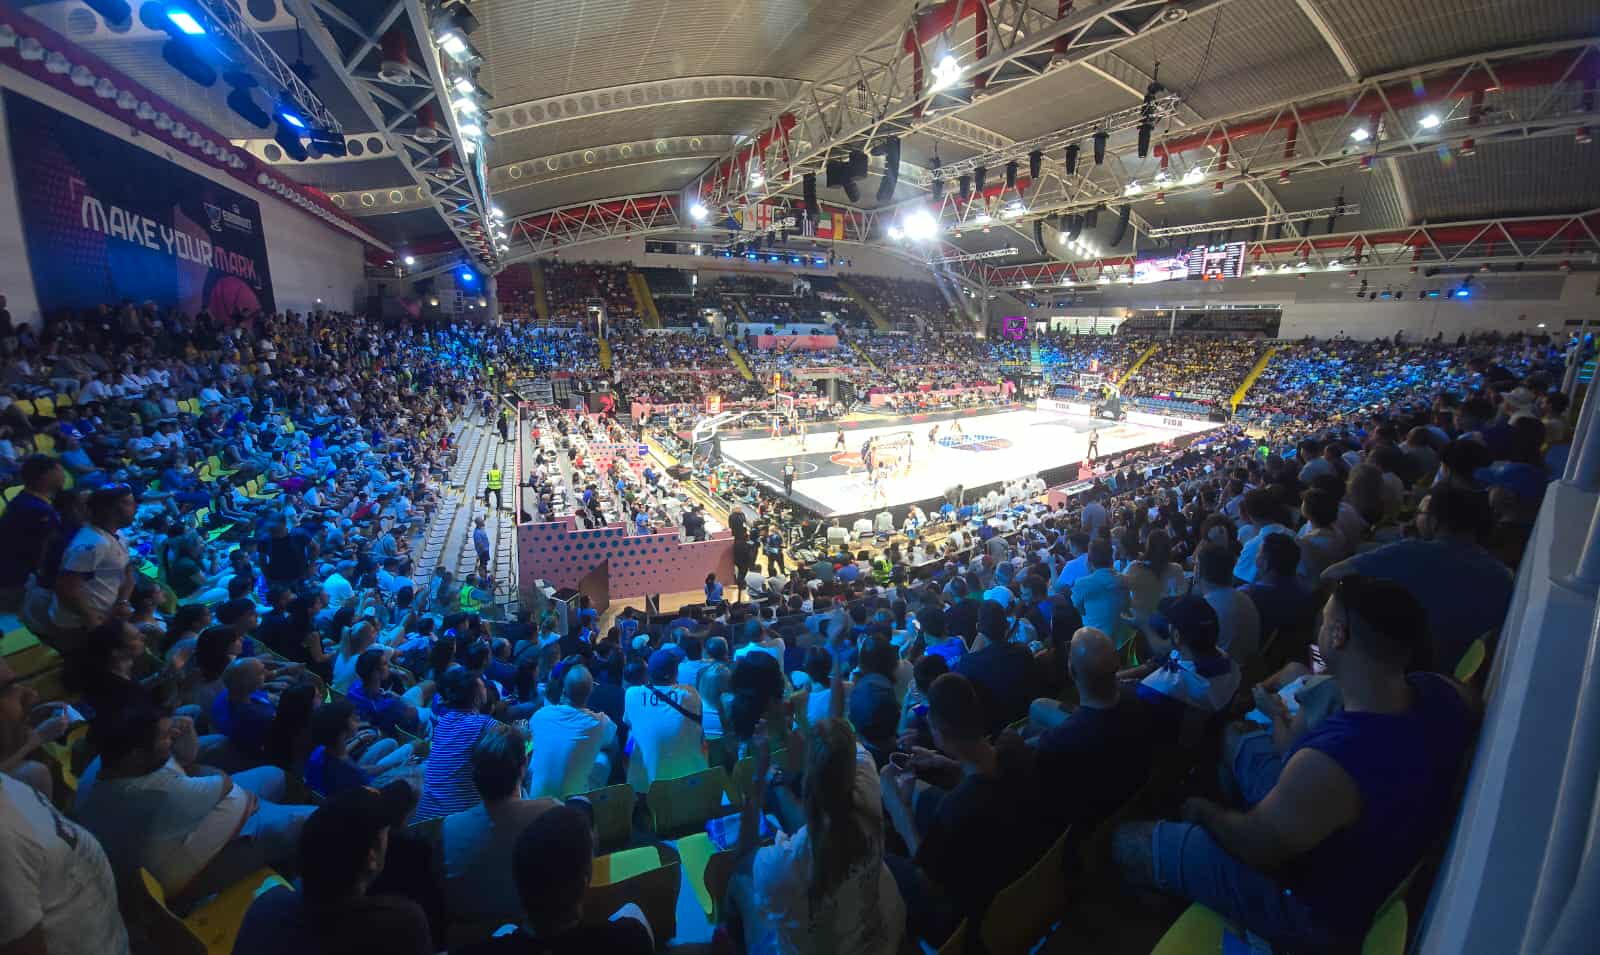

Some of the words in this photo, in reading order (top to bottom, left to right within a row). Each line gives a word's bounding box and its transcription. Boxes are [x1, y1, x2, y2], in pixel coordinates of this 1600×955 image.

[81, 196, 160, 251] MAKE
[160, 224, 213, 267] YOUR
[213, 245, 257, 280] MARK
